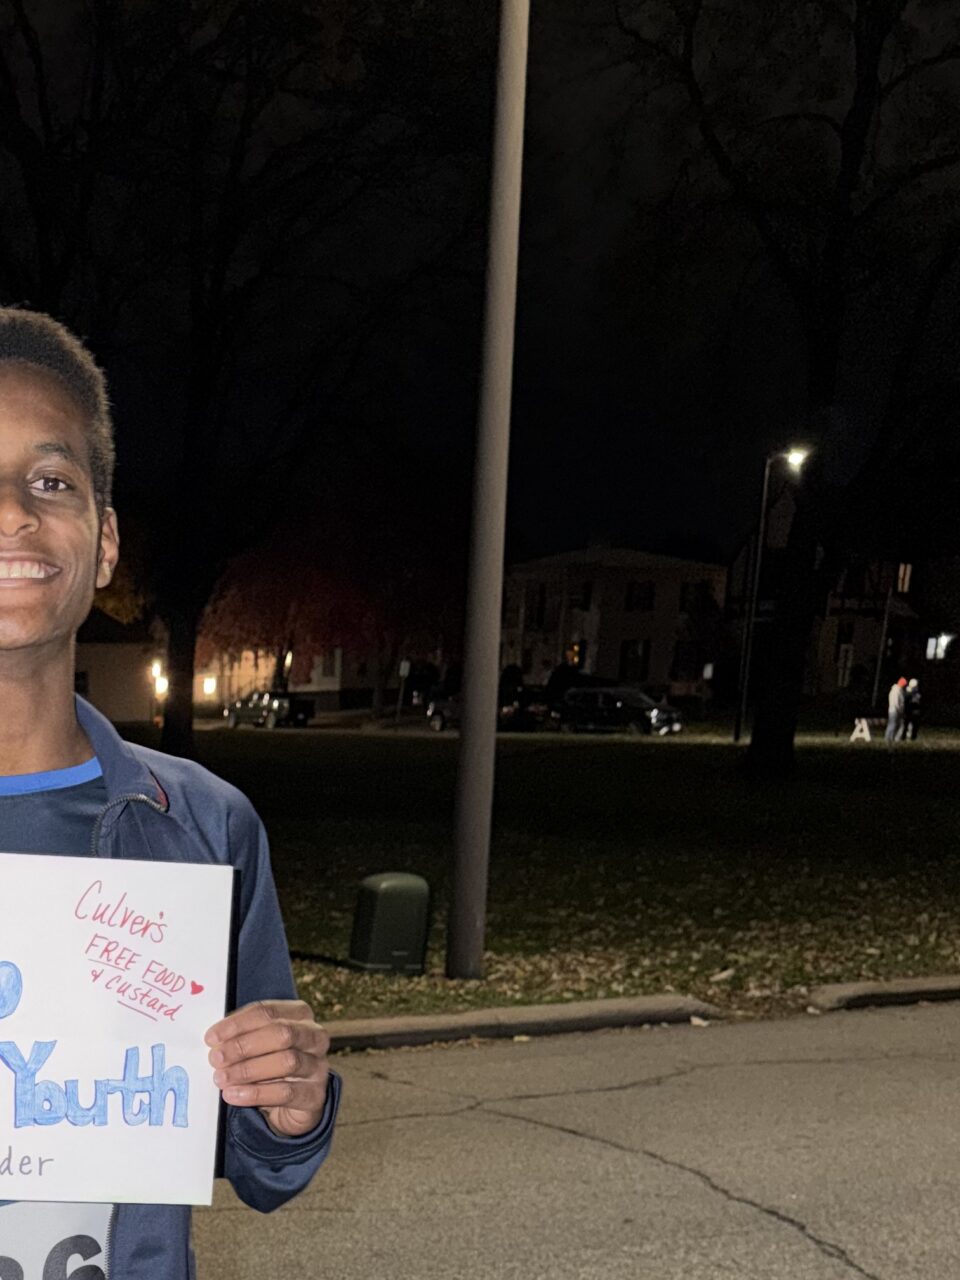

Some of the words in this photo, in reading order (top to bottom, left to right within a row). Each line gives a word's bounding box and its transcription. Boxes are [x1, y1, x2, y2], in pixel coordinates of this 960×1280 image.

[74, 879, 168, 944] Culver's
[85, 933, 143, 971] FREE
[141, 959, 187, 994] FOOD
